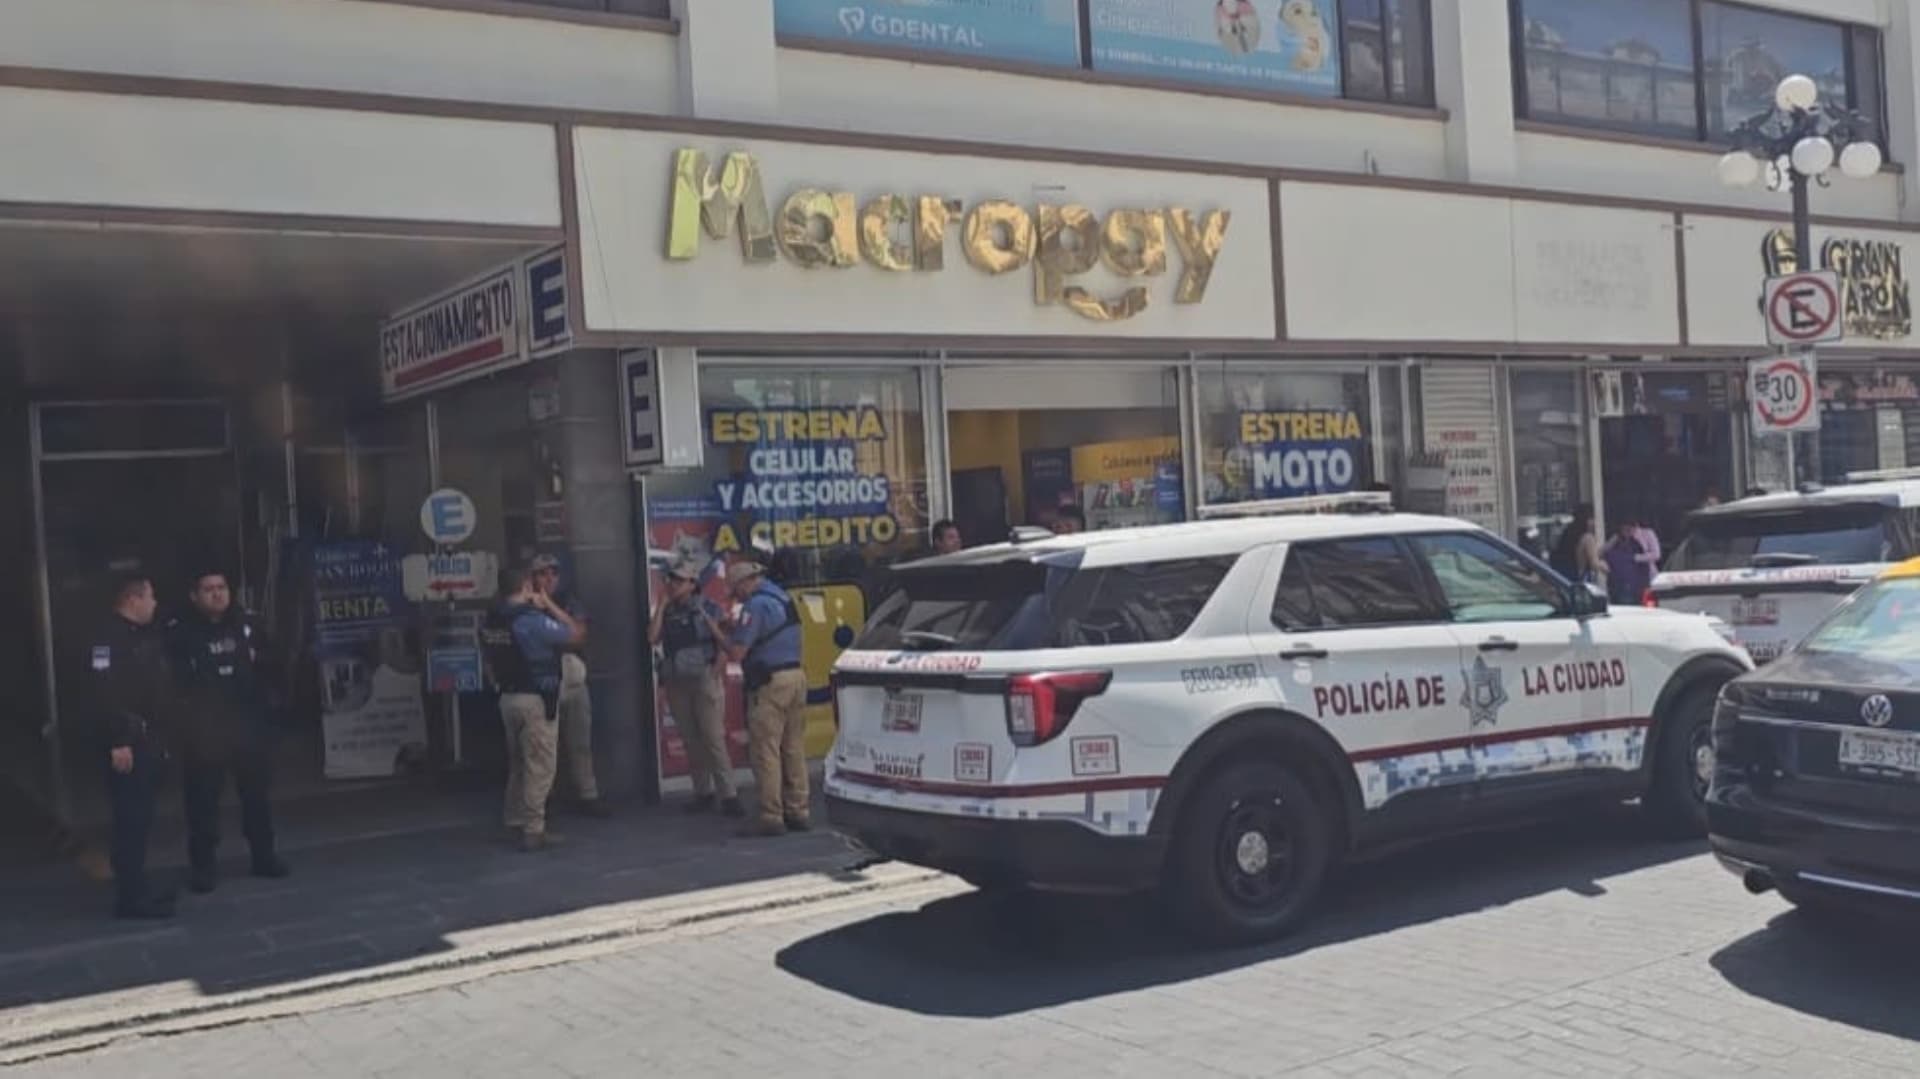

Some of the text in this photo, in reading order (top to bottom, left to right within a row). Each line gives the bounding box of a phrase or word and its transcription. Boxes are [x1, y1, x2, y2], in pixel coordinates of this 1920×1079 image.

[871, 15, 983, 48] GDENTAL
[664, 148, 1231, 304] Macropay
[1822, 237, 1902, 282] GRAN
[529, 257, 569, 342] E
[1843, 280, 1911, 320] ARON
[383, 278, 513, 373] ESTACIONAMIENTO
[627, 359, 653, 451] E
[1770, 373, 1798, 403] 30
[711, 409, 885, 443] ESTRENA
[1240, 411, 1361, 443] ESTRENA
[750, 446, 855, 475] CELULAR
[1253, 449, 1353, 489] MOTO
[717, 483, 737, 510] Y
[742, 477, 888, 509] ACCESORIOS
[430, 496, 466, 537] E
[714, 513, 897, 550] A CRÉDITO
[318, 597, 390, 621] RENTA
[1313, 658, 1626, 718] POLICÍA DE LA CIUDAD
